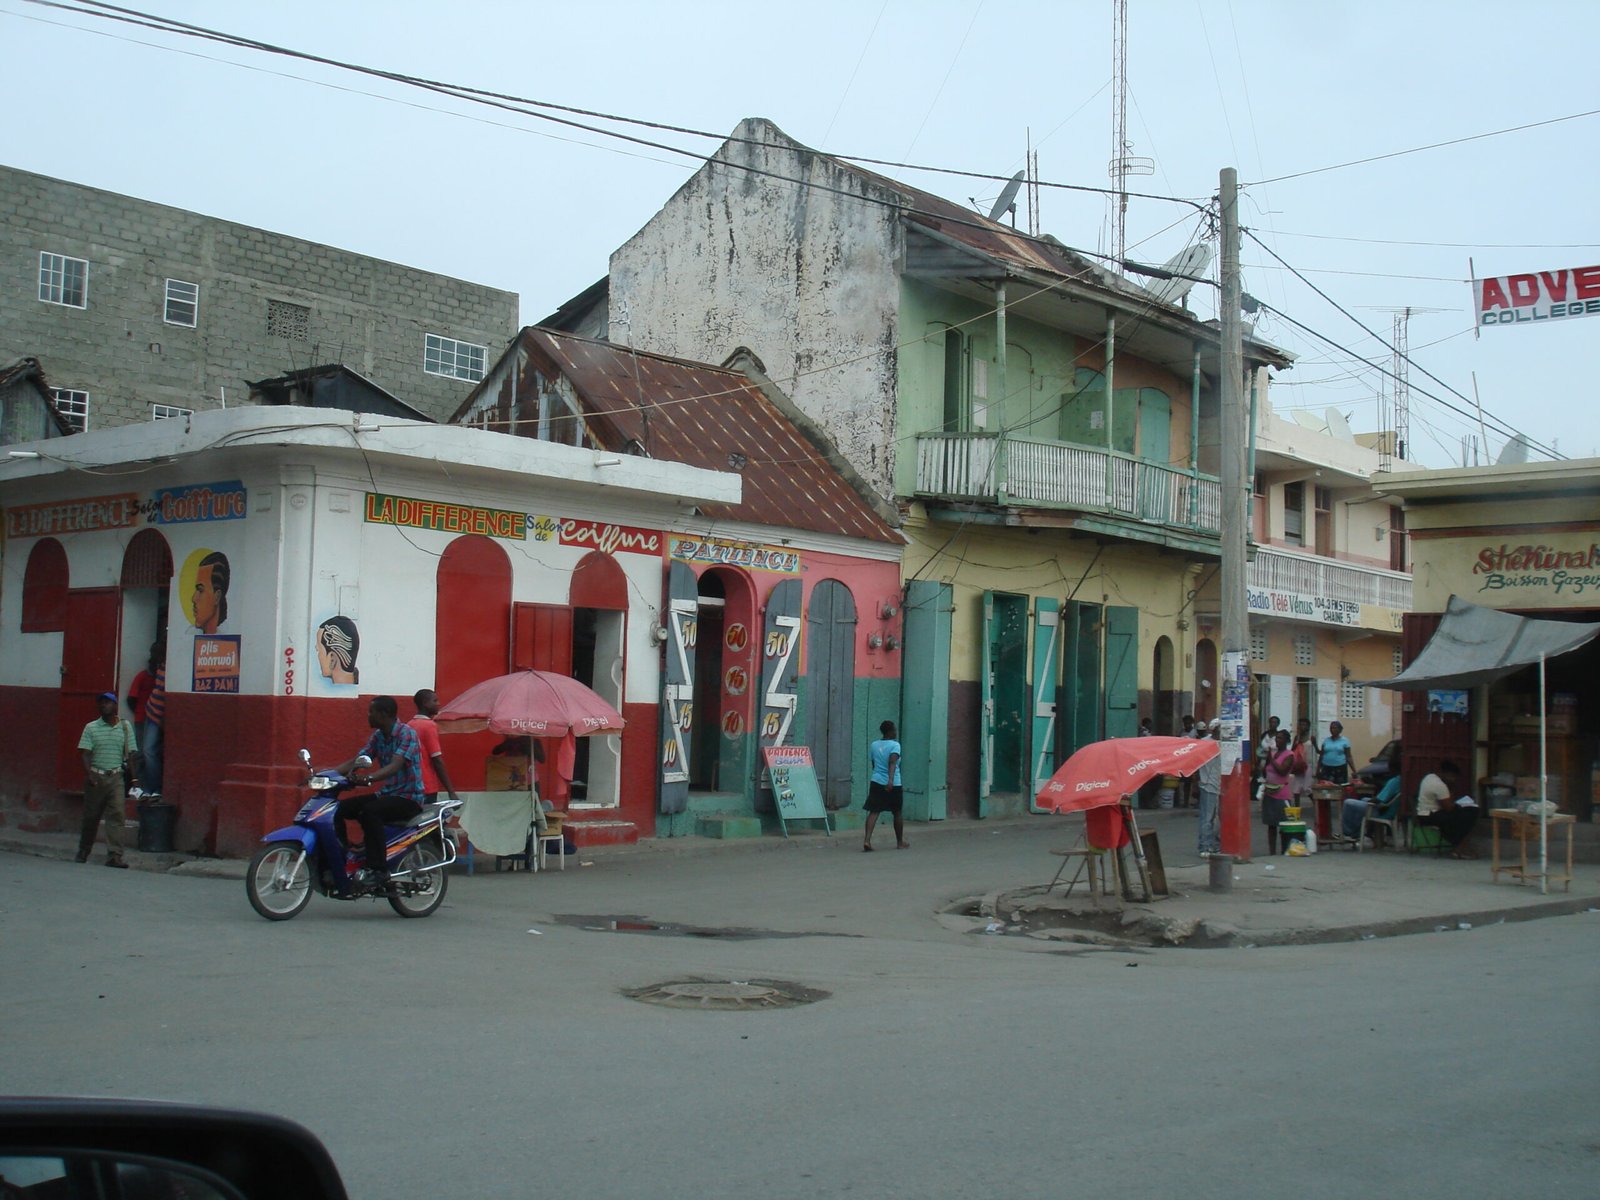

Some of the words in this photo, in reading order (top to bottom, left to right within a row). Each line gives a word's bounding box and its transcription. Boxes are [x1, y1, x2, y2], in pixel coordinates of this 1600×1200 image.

[1481, 265, 1600, 311] ADVE
[1481, 300, 1600, 325] COLLEGE
[526, 515, 564, 532] Salon
[534, 531, 548, 542] de
[560, 520, 659, 553] Coiffure
[672, 540, 798, 572] PATIENCE
[1478, 573, 1548, 593] Boisson
[766, 631, 789, 658] 50
[761, 712, 781, 737] 15
[1075, 779, 1111, 792] Digicel
